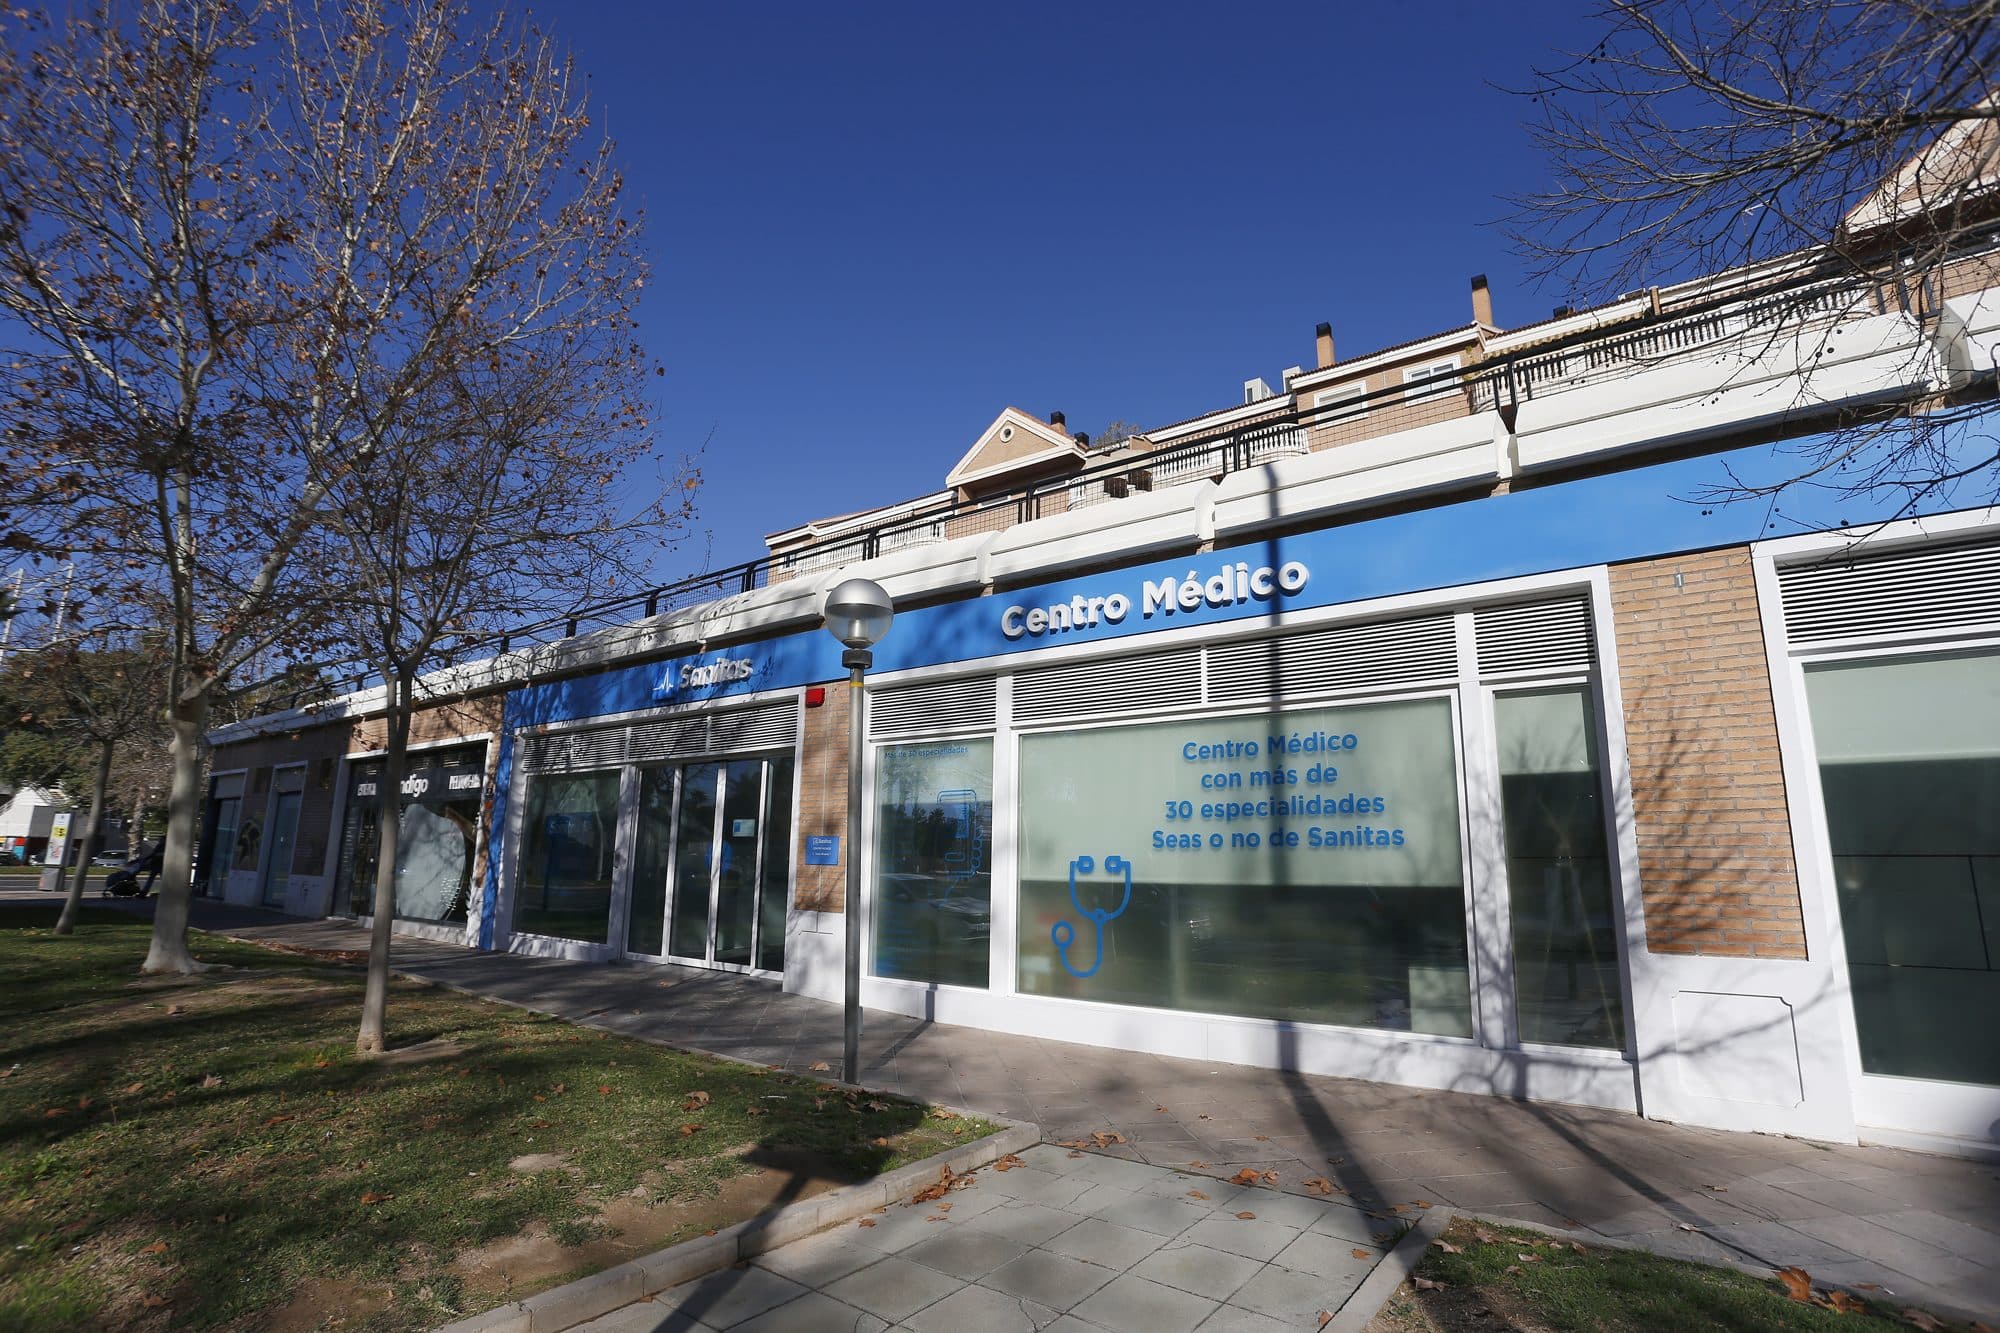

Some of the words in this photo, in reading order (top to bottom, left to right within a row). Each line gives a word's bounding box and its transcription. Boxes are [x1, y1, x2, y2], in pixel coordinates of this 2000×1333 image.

[1001, 593, 1131, 638] Centro
[1143, 561, 1309, 615] Médico
[679, 658, 753, 688] Sanitas
[1182, 739, 1259, 761] Centro
[1267, 731, 1358, 754] Médico
[1201, 771, 1242, 789] con
[1250, 764, 1298, 786] más
[1306, 762, 1338, 784] de
[1165, 800, 1193, 819] 30
[1200, 793, 1385, 822] especialidades
[1152, 830, 1201, 849] Seas
[1209, 831, 1223, 848] o
[1231, 831, 1260, 849] no
[1269, 827, 1299, 848] de
[1308, 825, 1405, 847] Sanitas
